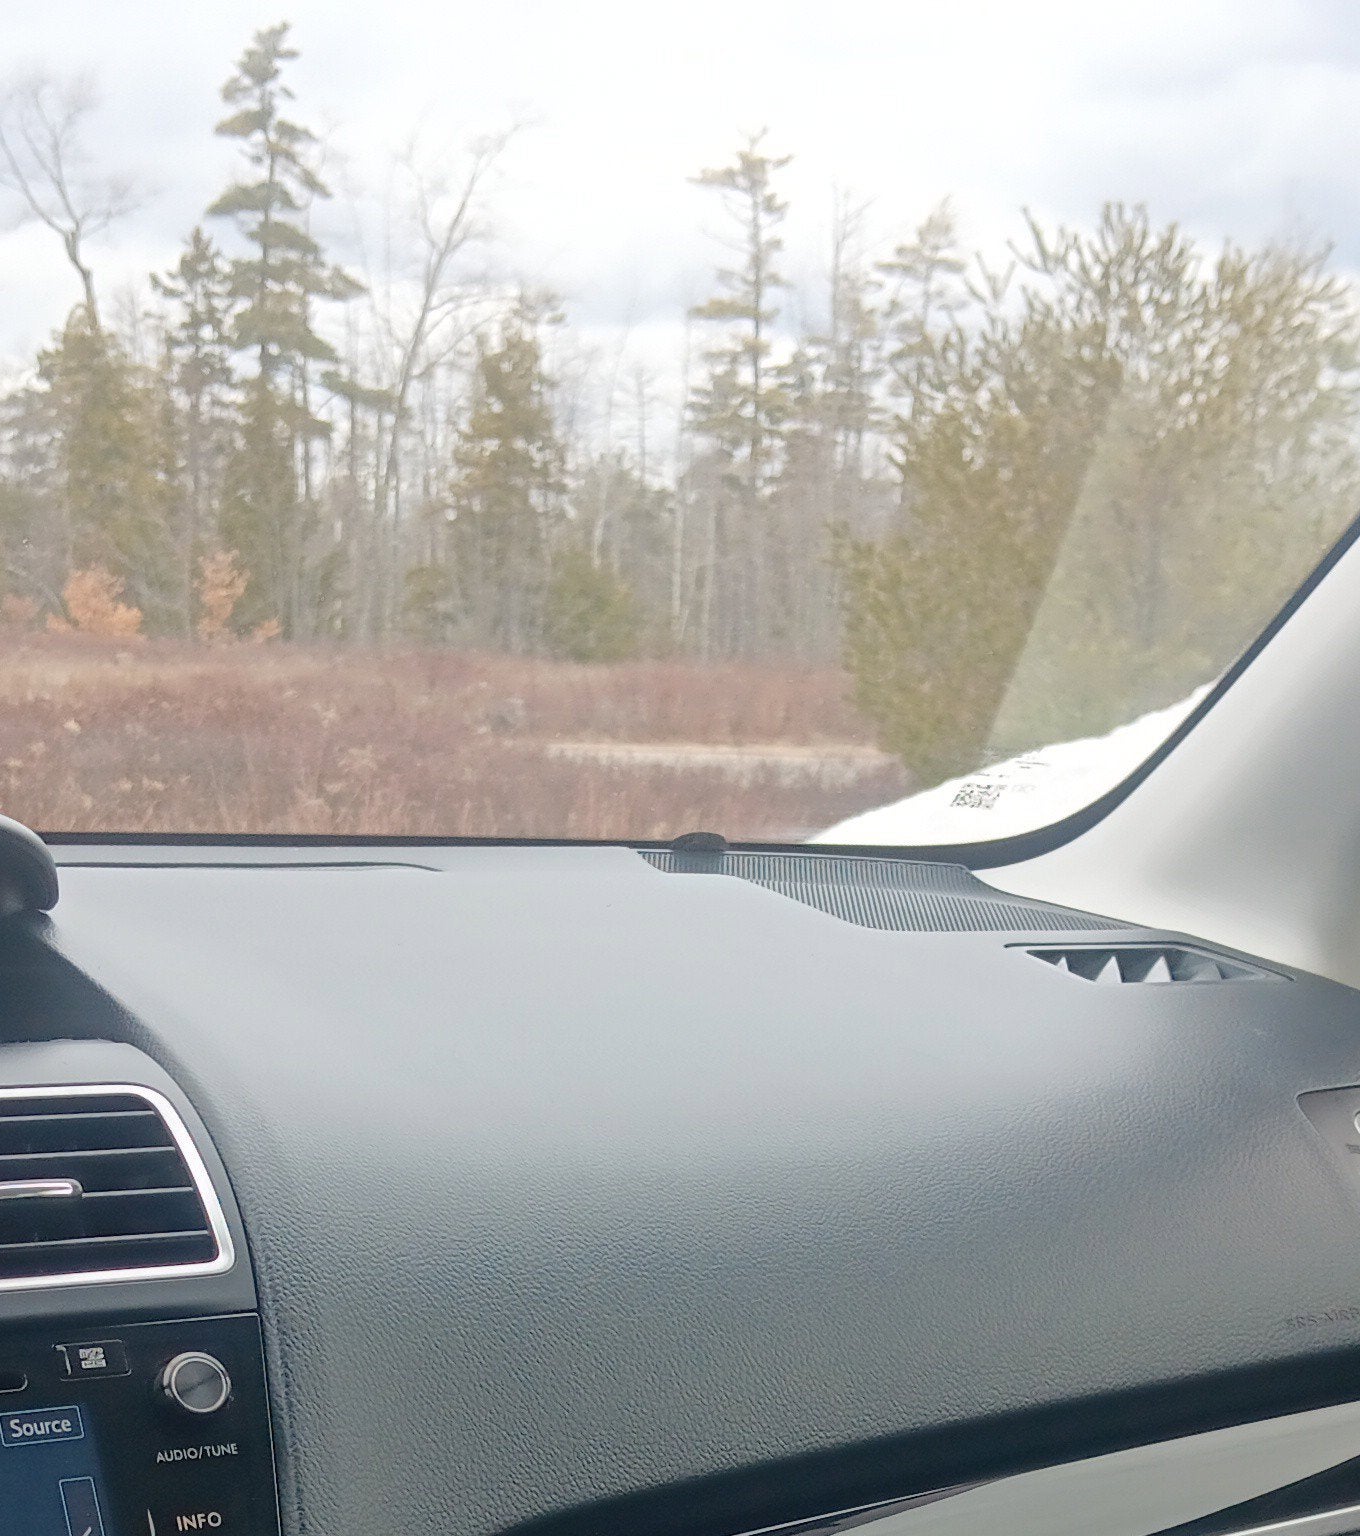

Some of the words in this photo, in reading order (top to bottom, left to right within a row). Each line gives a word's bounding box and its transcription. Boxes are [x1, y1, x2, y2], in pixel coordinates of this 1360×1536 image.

[9, 1417, 72, 1438] Source
[156, 1443, 239, 1463] AUDIO/TUNE
[176, 1511, 222, 1532] INFO
